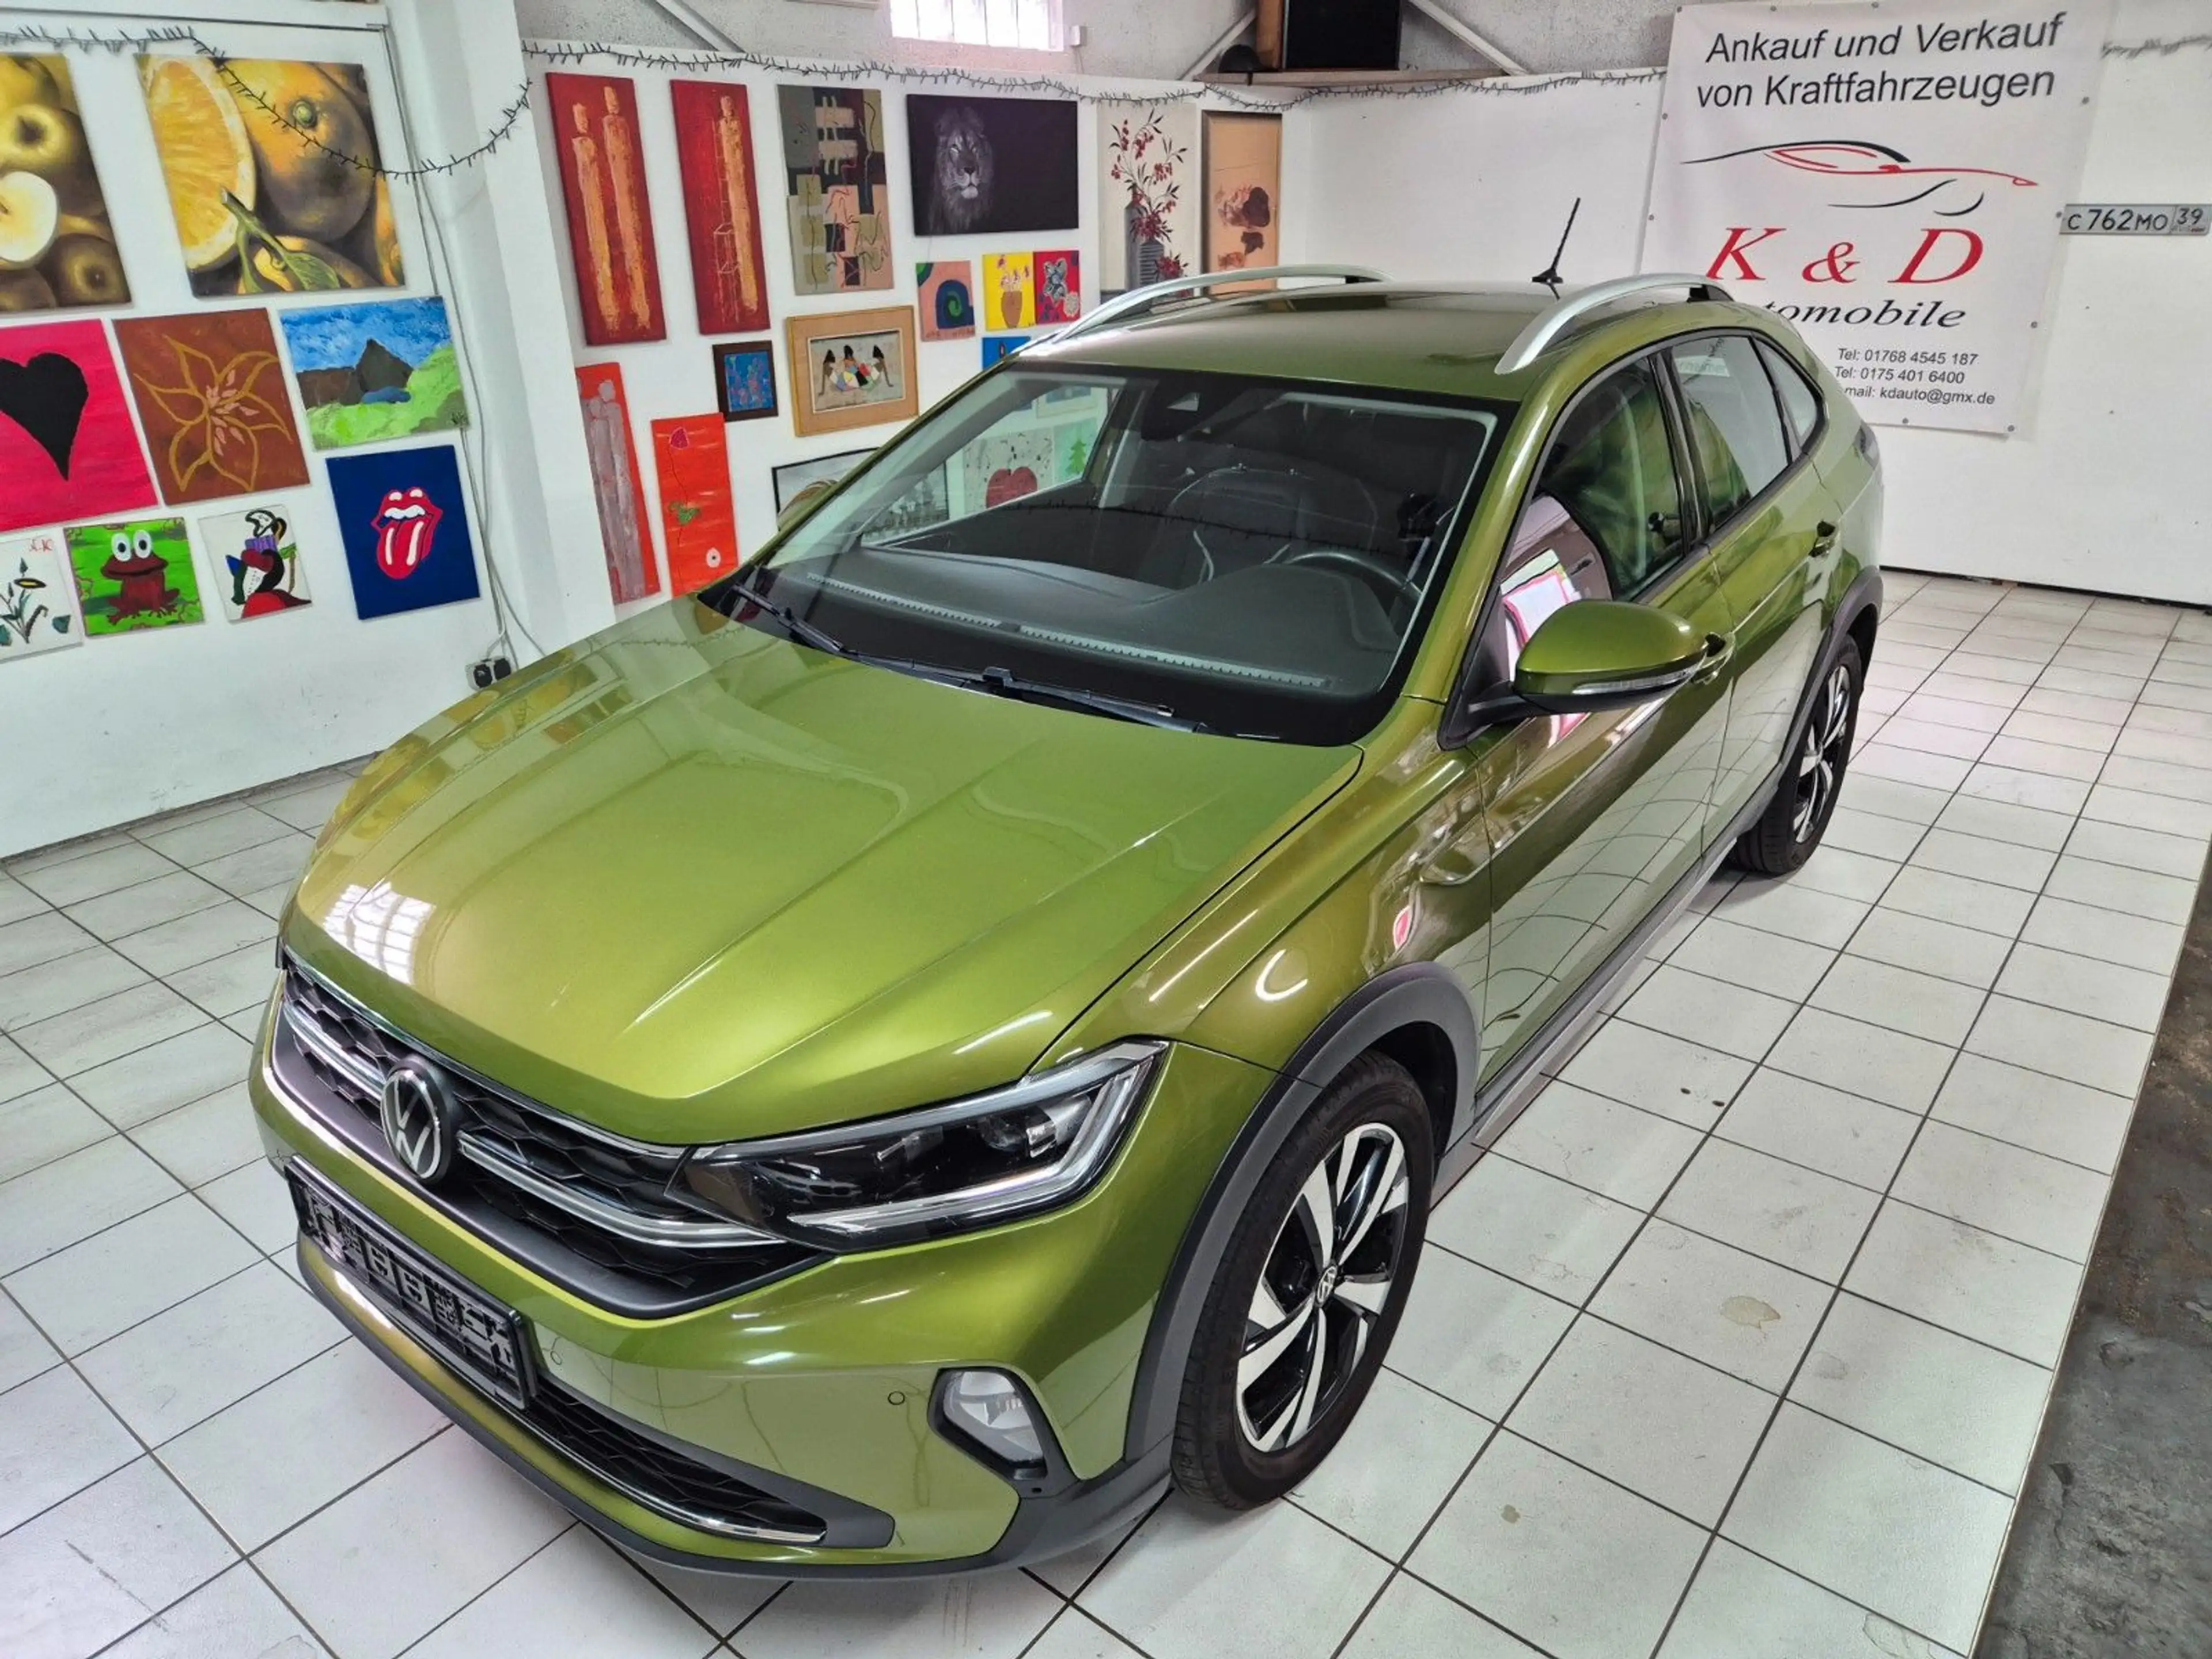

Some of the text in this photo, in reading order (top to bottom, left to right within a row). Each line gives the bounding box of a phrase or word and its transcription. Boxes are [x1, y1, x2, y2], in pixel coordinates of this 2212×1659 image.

[1705, 11, 2067, 63] Ankauf und Verkauf
[1697, 70, 2055, 108] von Kraftfahrzeugen
[1706, 228, 1983, 284] K & D
[1838, 348, 1979, 365] Tel: 01768 4545 187
[1834, 366, 1965, 384] Tel: 0175 401 6400
[1880, 387, 1996, 404] kdauto@gmx.de
